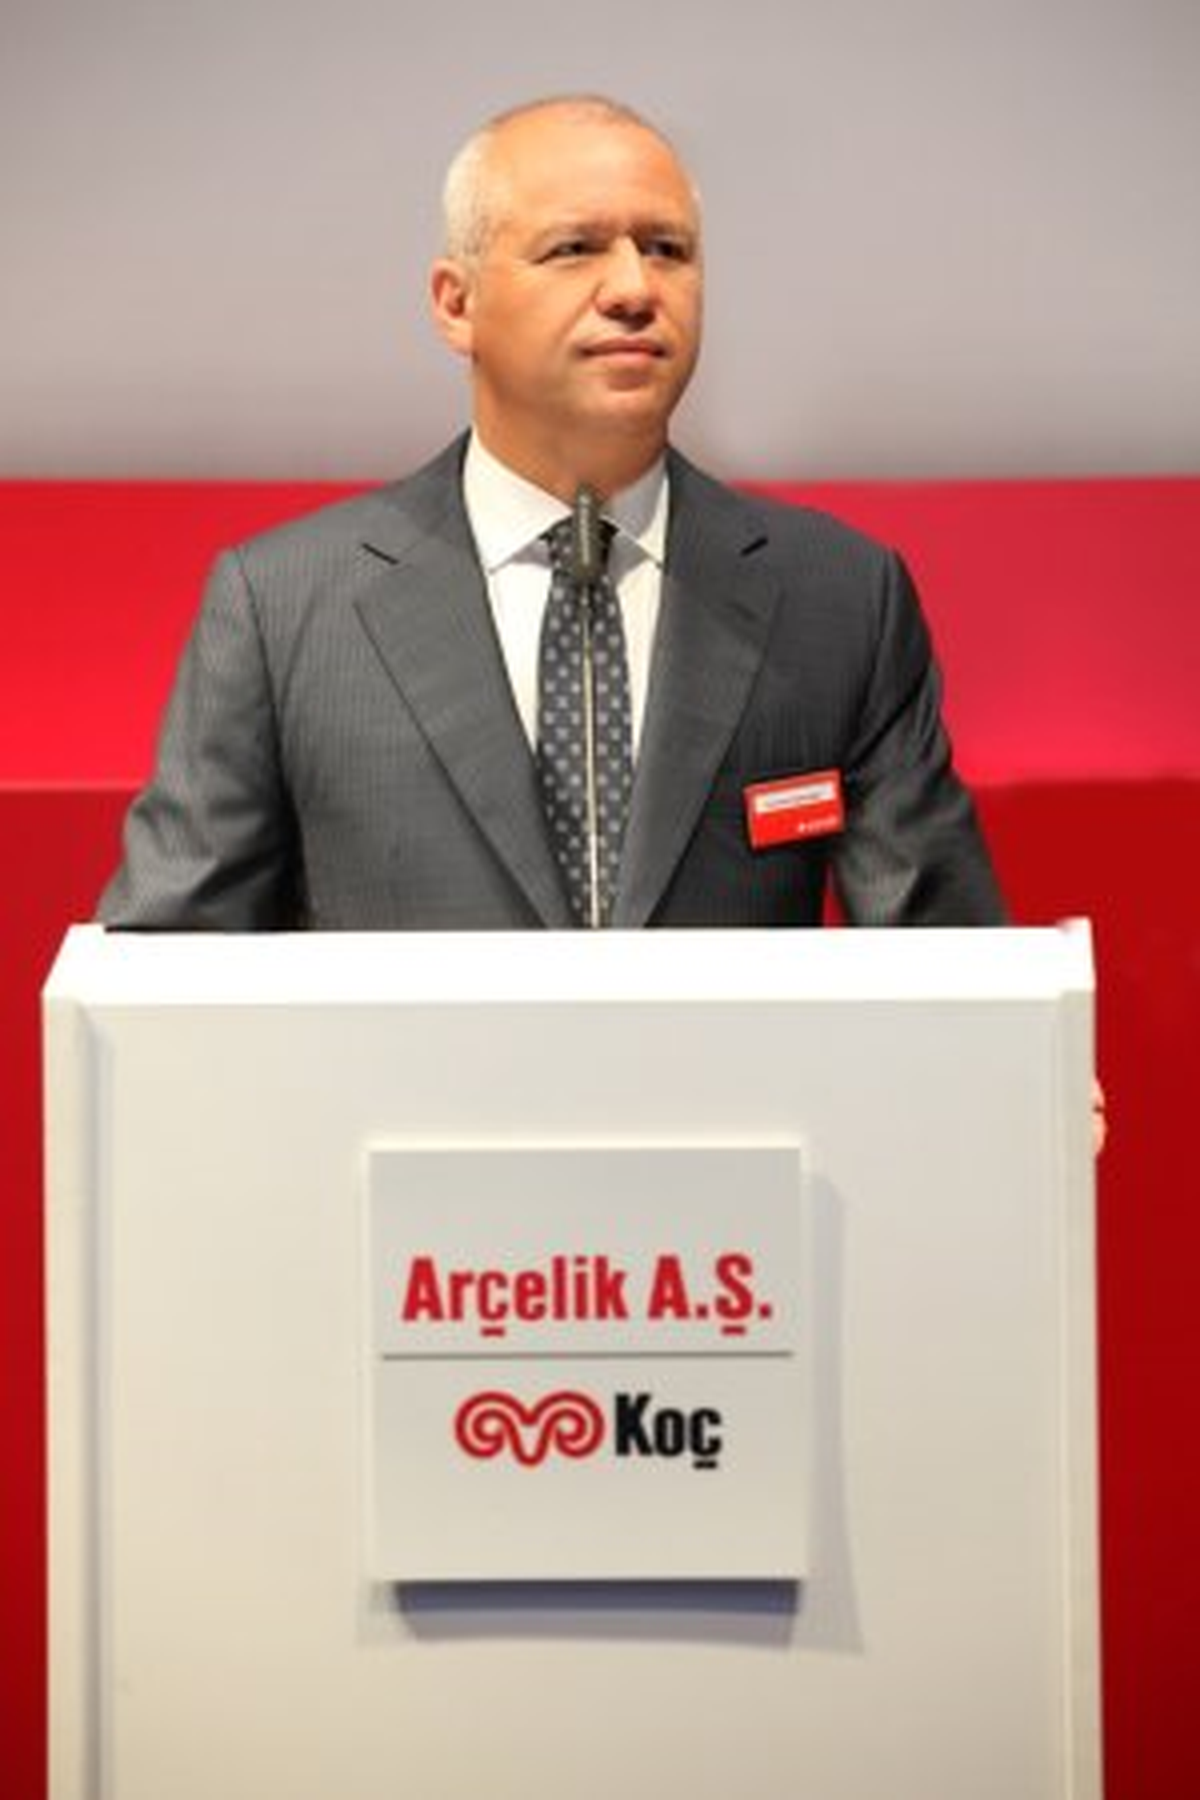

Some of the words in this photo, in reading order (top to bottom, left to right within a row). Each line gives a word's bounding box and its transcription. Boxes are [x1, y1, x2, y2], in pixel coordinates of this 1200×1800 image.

[402, 1255, 629, 1338] Arçelik
[648, 1253, 772, 1336] A.Ş.
[615, 1393, 722, 1470] Koç
